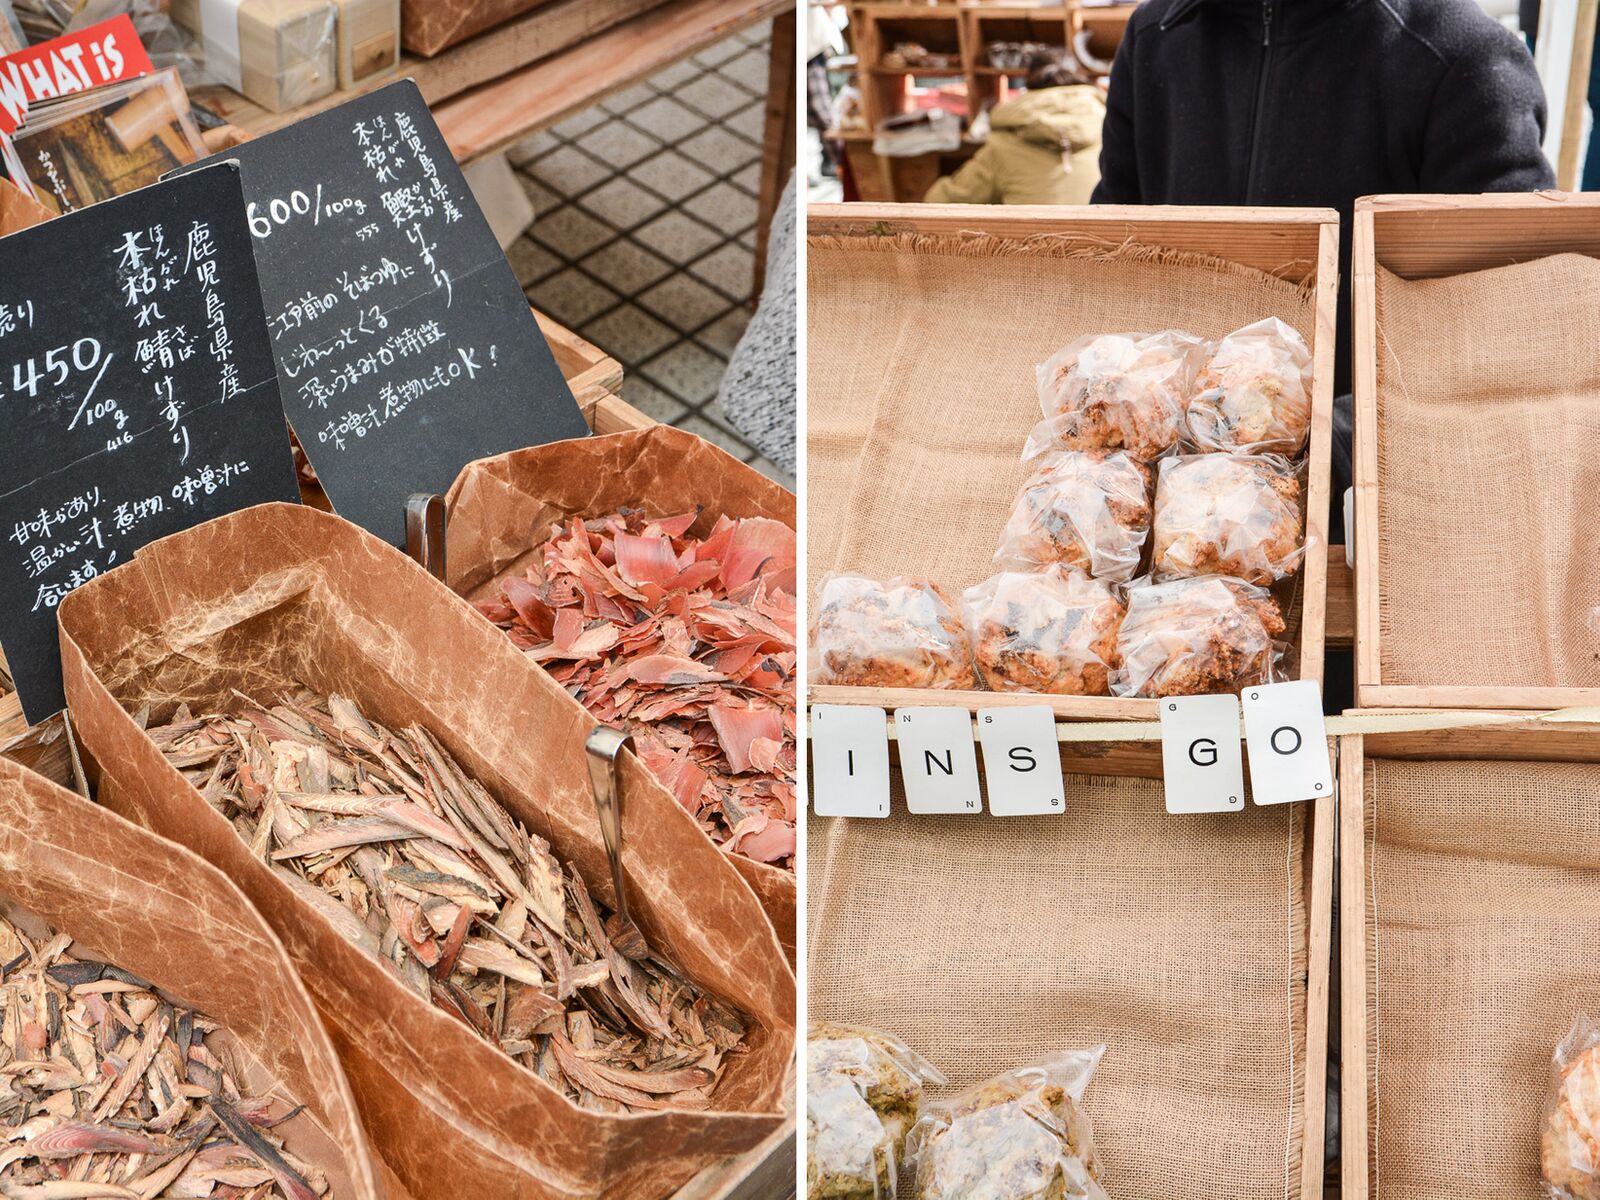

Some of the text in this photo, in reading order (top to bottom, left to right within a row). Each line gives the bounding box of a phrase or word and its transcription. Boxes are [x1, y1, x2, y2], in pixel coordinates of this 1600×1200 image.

[0, 42, 93, 127] WHAT
[394, 111, 463, 224] 鹿児島県産
[355, 222, 380, 242] 555
[184, 220, 247, 404] 鹿児島県産
[171, 324, 200, 362] さば
[107, 432, 134, 452] 416
